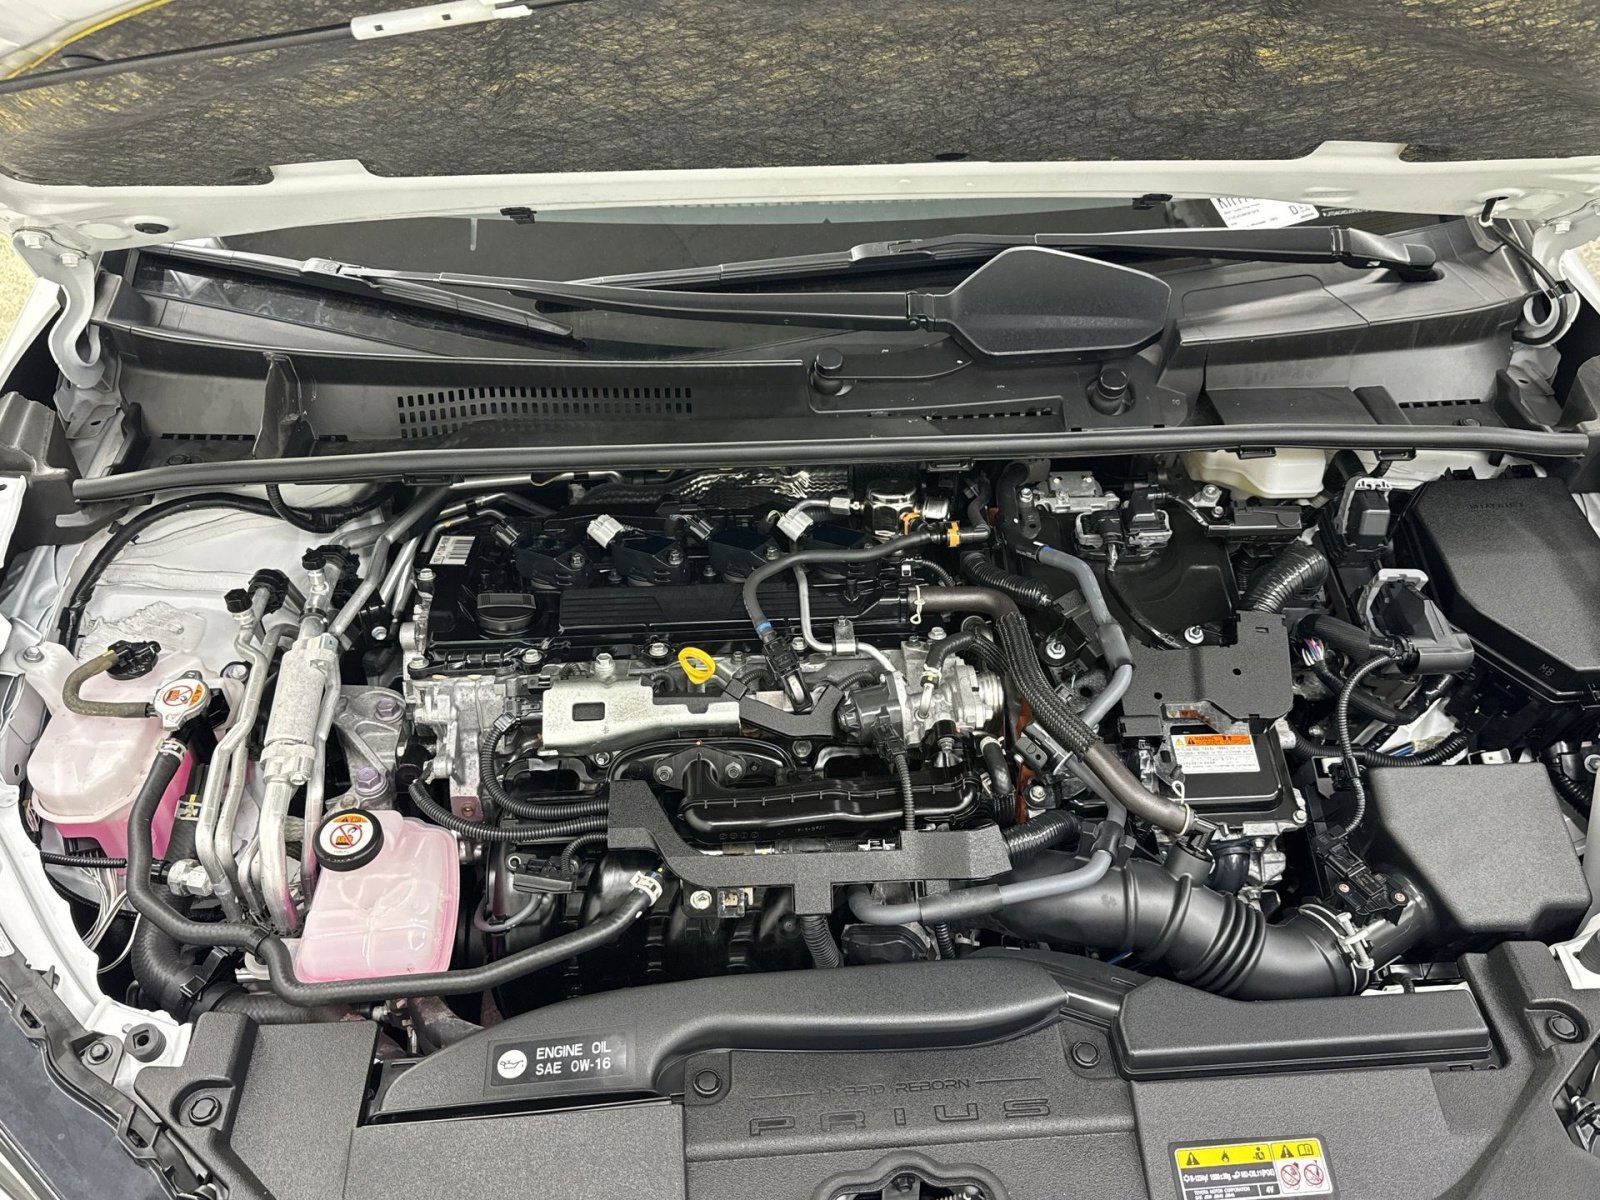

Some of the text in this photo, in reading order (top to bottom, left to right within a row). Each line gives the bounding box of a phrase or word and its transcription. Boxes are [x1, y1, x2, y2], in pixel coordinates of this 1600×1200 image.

[535, 1040, 612, 1060] ENGINE OIL
[535, 1056, 612, 1076] SAE 0W-16
[819, 1078, 971, 1098] HYBRID REBORN
[749, 1098, 1051, 1137] PRIUS
